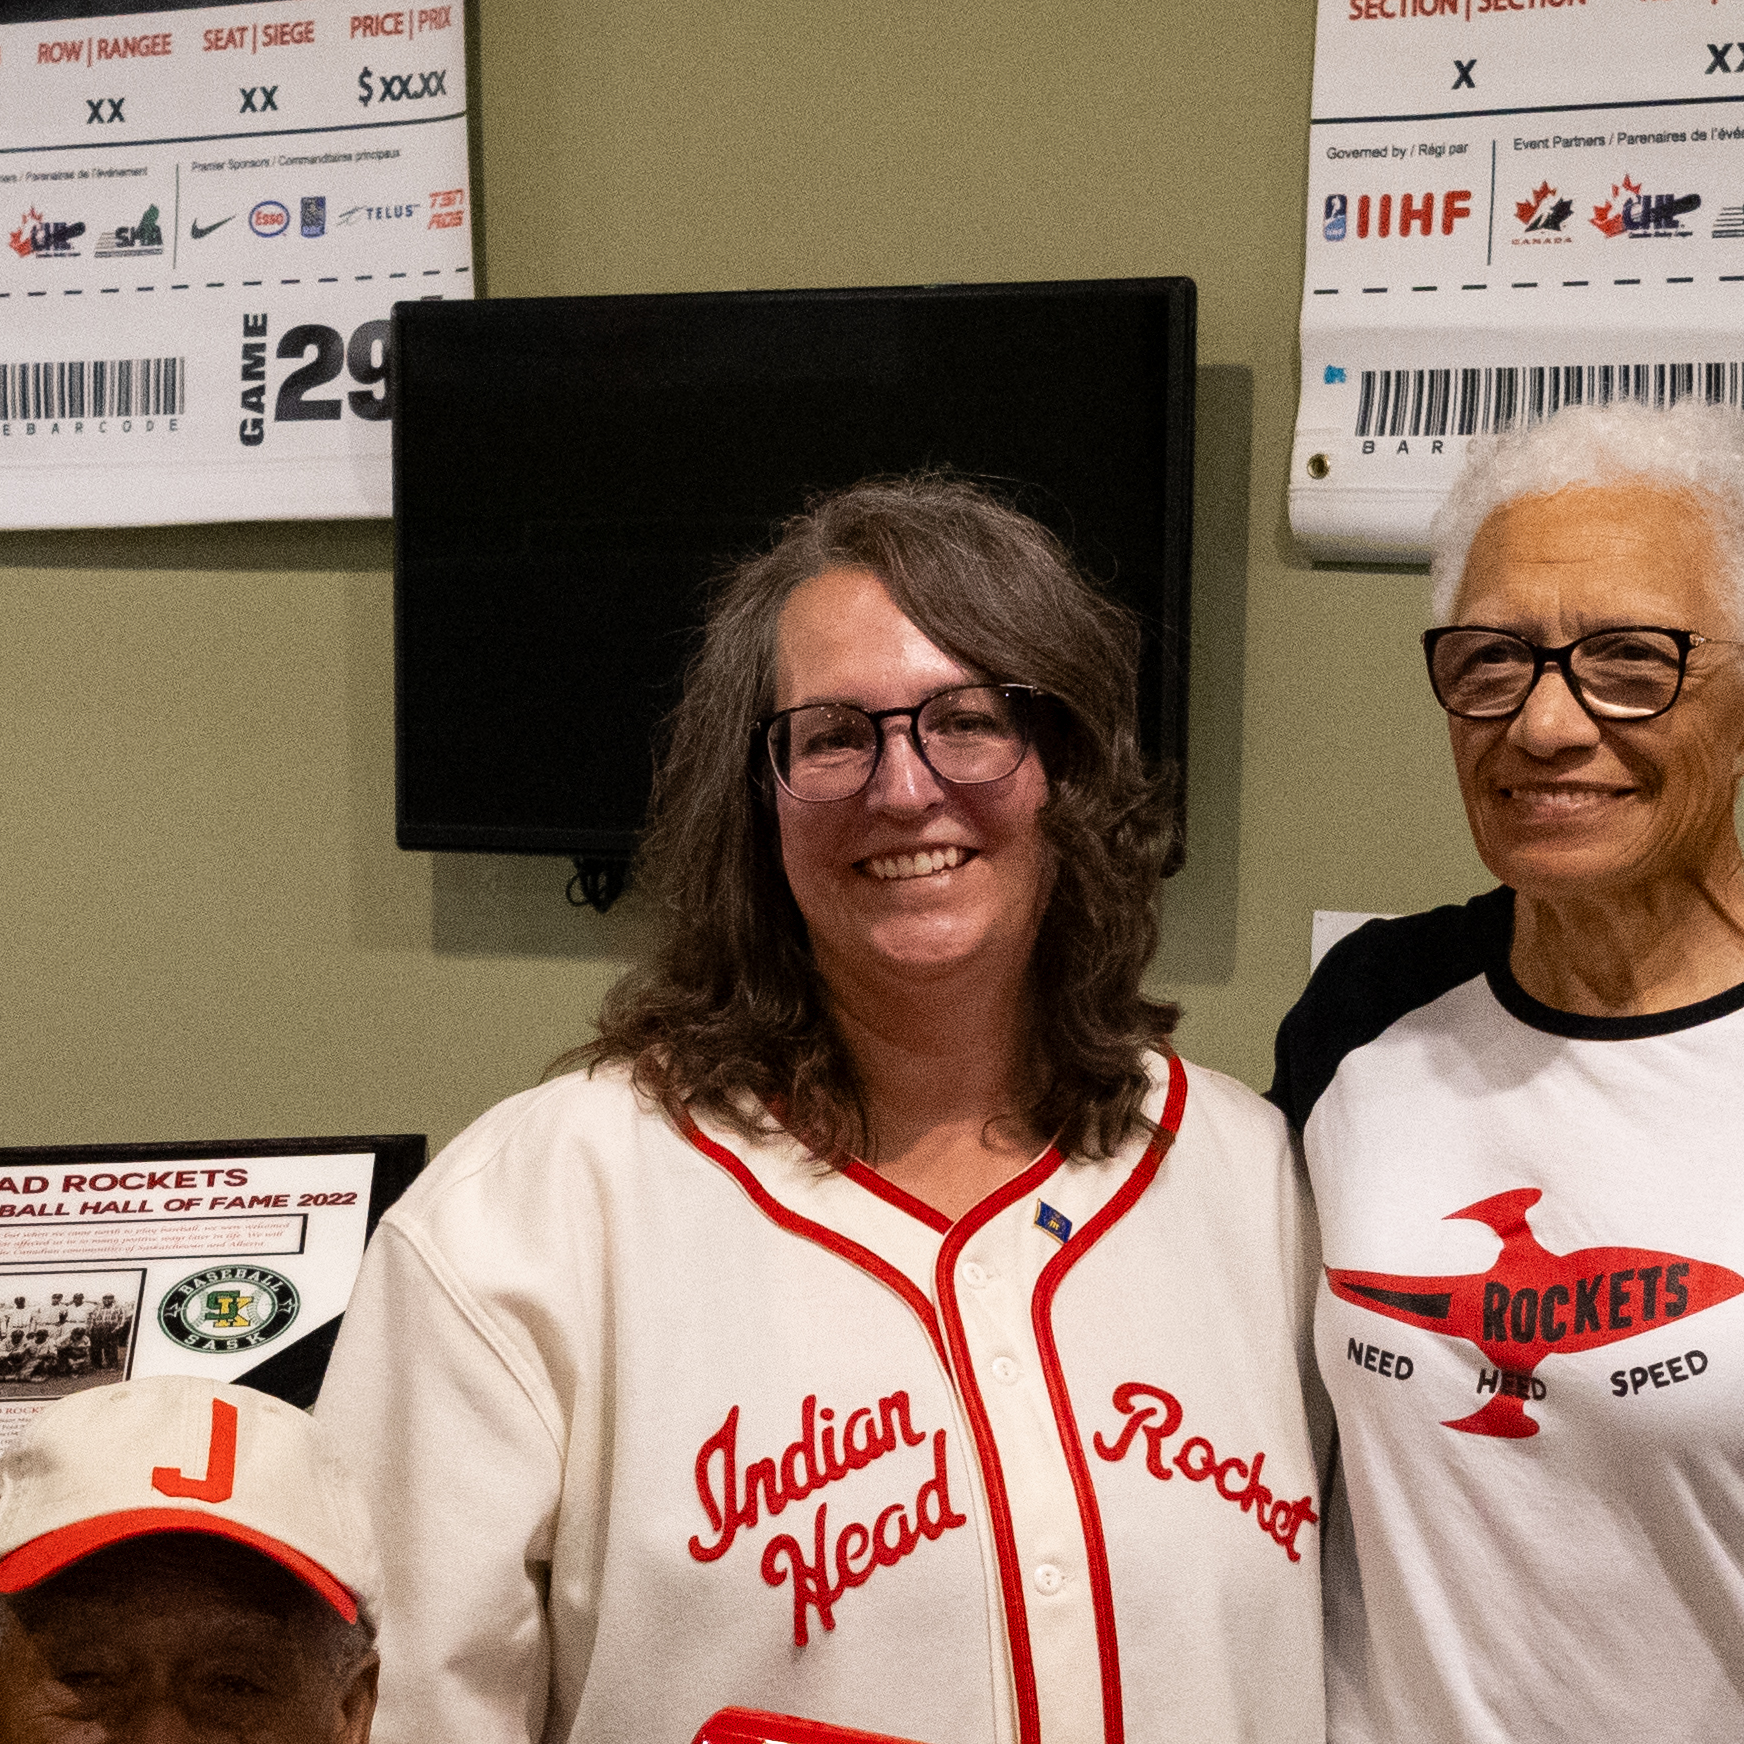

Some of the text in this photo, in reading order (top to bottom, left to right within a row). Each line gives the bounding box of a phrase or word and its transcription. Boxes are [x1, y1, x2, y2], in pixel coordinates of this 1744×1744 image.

[203, 20, 315, 51] SEAT SIEGE
[350, 6, 451, 39] PRICE PRIX
[37, 33, 172, 64] ROW RANGEE
[1451, 59, 1477, 90] X
[1327, 146, 1387, 160] Governed
[1392, 146, 1406, 160] by
[1449, 143, 1469, 157] par
[1514, 136, 1550, 151] Event
[1553, 134, 1605, 149] Partners
[1691, 128, 1707, 142] de
[366, 205, 414, 221] TELUS
[1357, 190, 1472, 239] IIHF
[238, 313, 269, 447] GAME
[61, 1168, 249, 1193] ROCKETS
[79, 1200, 154, 1215] HALL
[163, 1198, 203, 1212] OF
[209, 1194, 290, 1211] FAME
[297, 1192, 358, 1208] 2022
[177, 1267, 285, 1296] BASEBALL
[1483, 1262, 1691, 1344] ROCKETS
[183, 1332, 267, 1350] SASK
[1347, 1337, 1414, 1382] NEED
[1610, 1350, 1708, 1398] SPEED
[152, 1398, 238, 1503] J
[687, 1389, 926, 1563] Indian
[761, 1429, 967, 1646] Head
